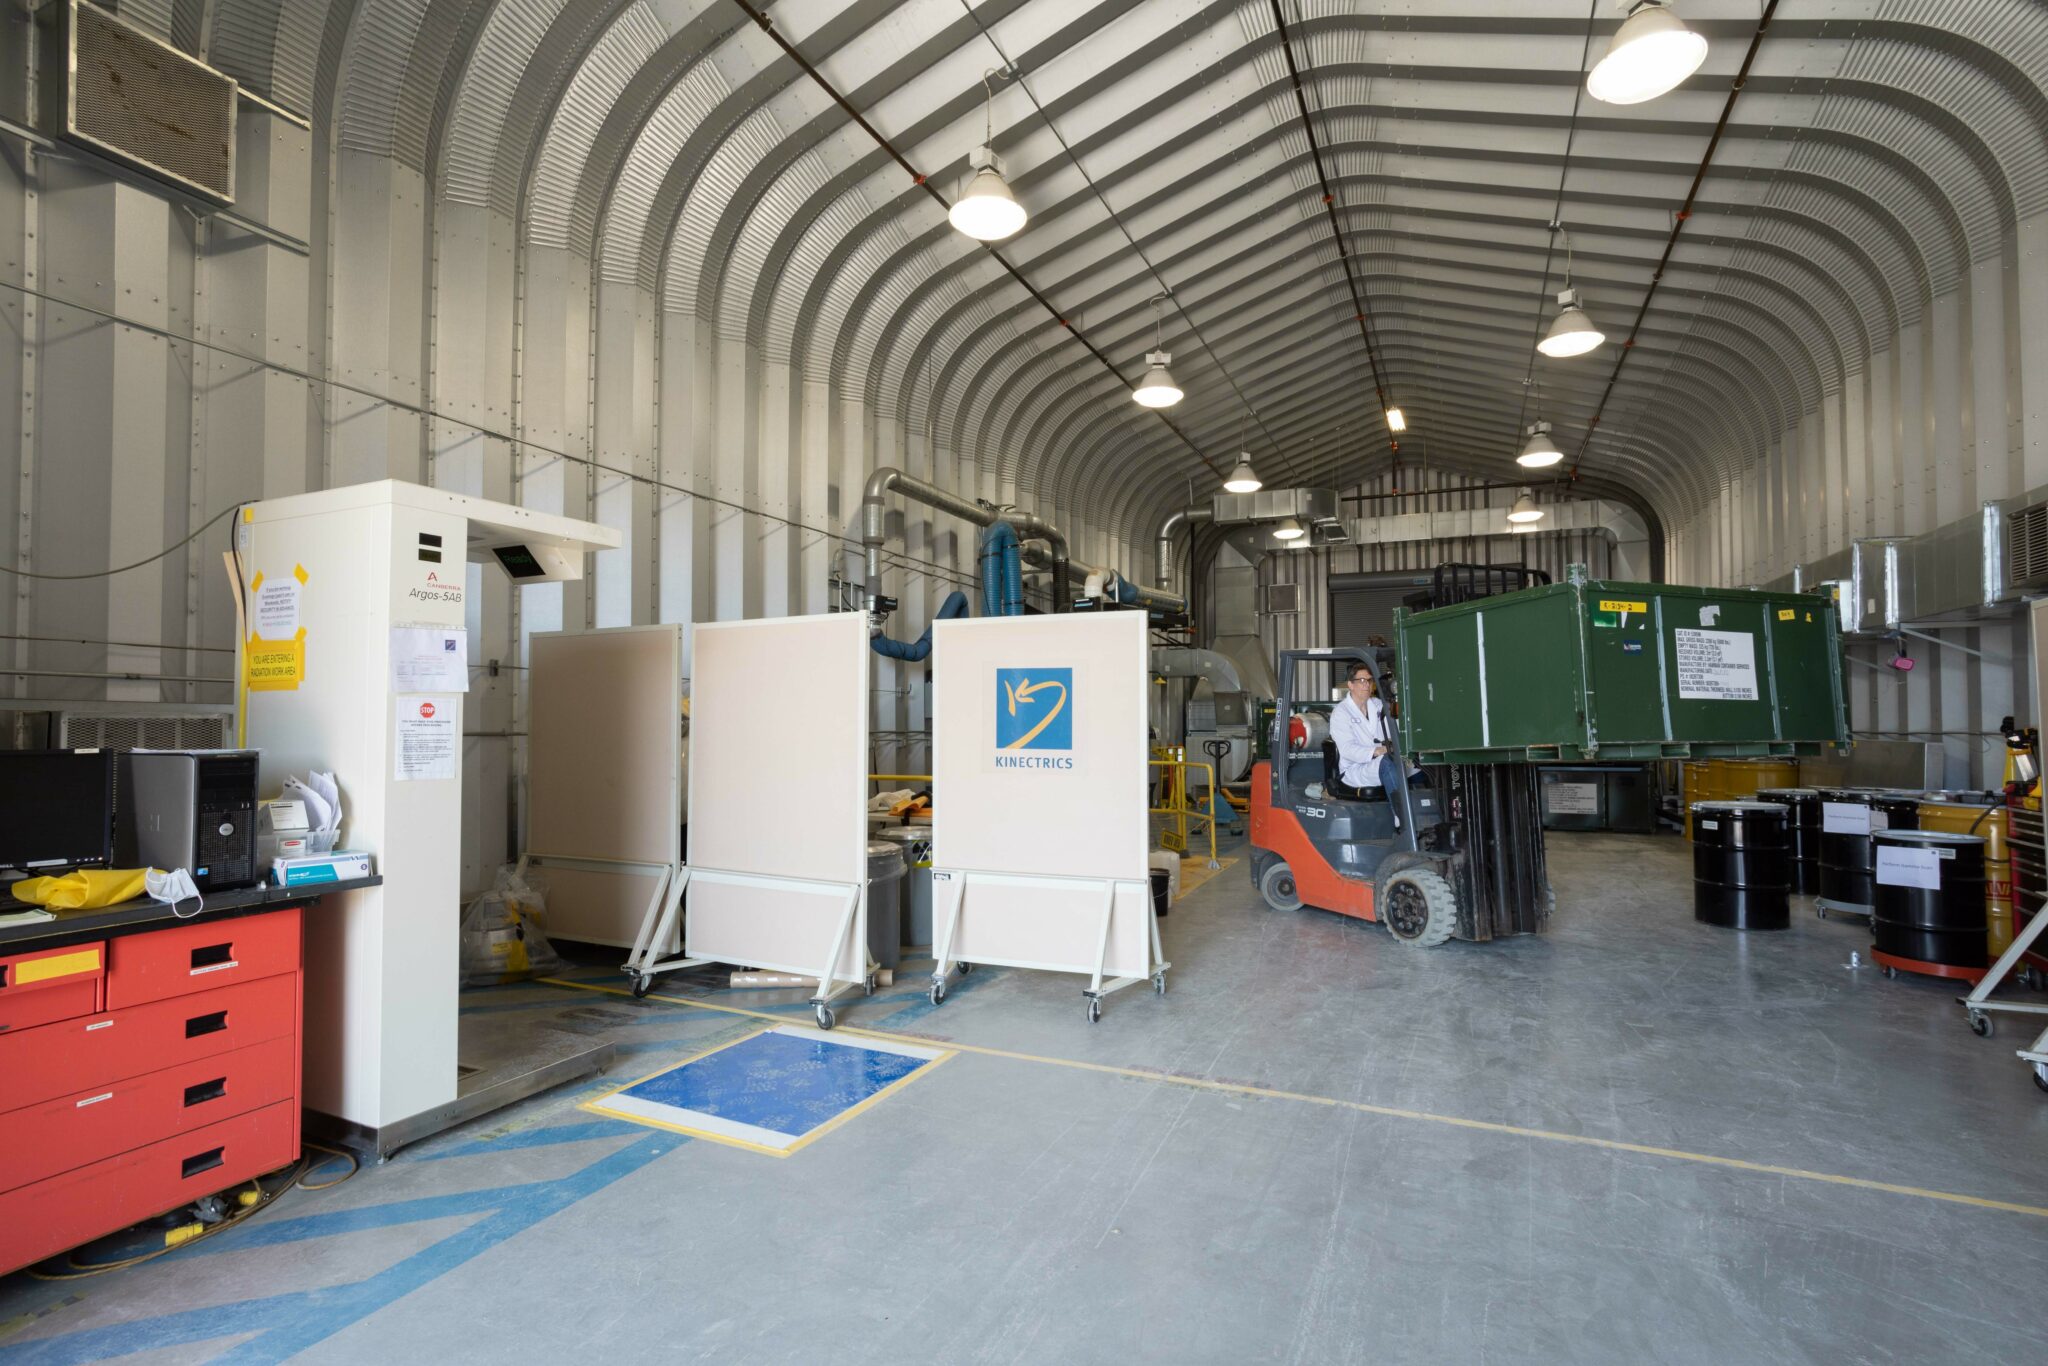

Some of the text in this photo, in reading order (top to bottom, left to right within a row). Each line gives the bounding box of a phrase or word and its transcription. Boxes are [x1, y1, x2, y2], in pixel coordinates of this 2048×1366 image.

[427, 583, 461, 591] CANBERRA
[409, 588, 462, 602] Argos-5AB
[253, 655, 261, 664] YOU
[262, 655, 270, 663] ARE
[270, 653, 290, 663] ENTERING
[251, 666, 296, 676] RADIATION WORK AREA
[421, 706, 434, 714] STOP
[995, 756, 1073, 769] KINECTRICS
[1306, 807, 1326, 818] 30
